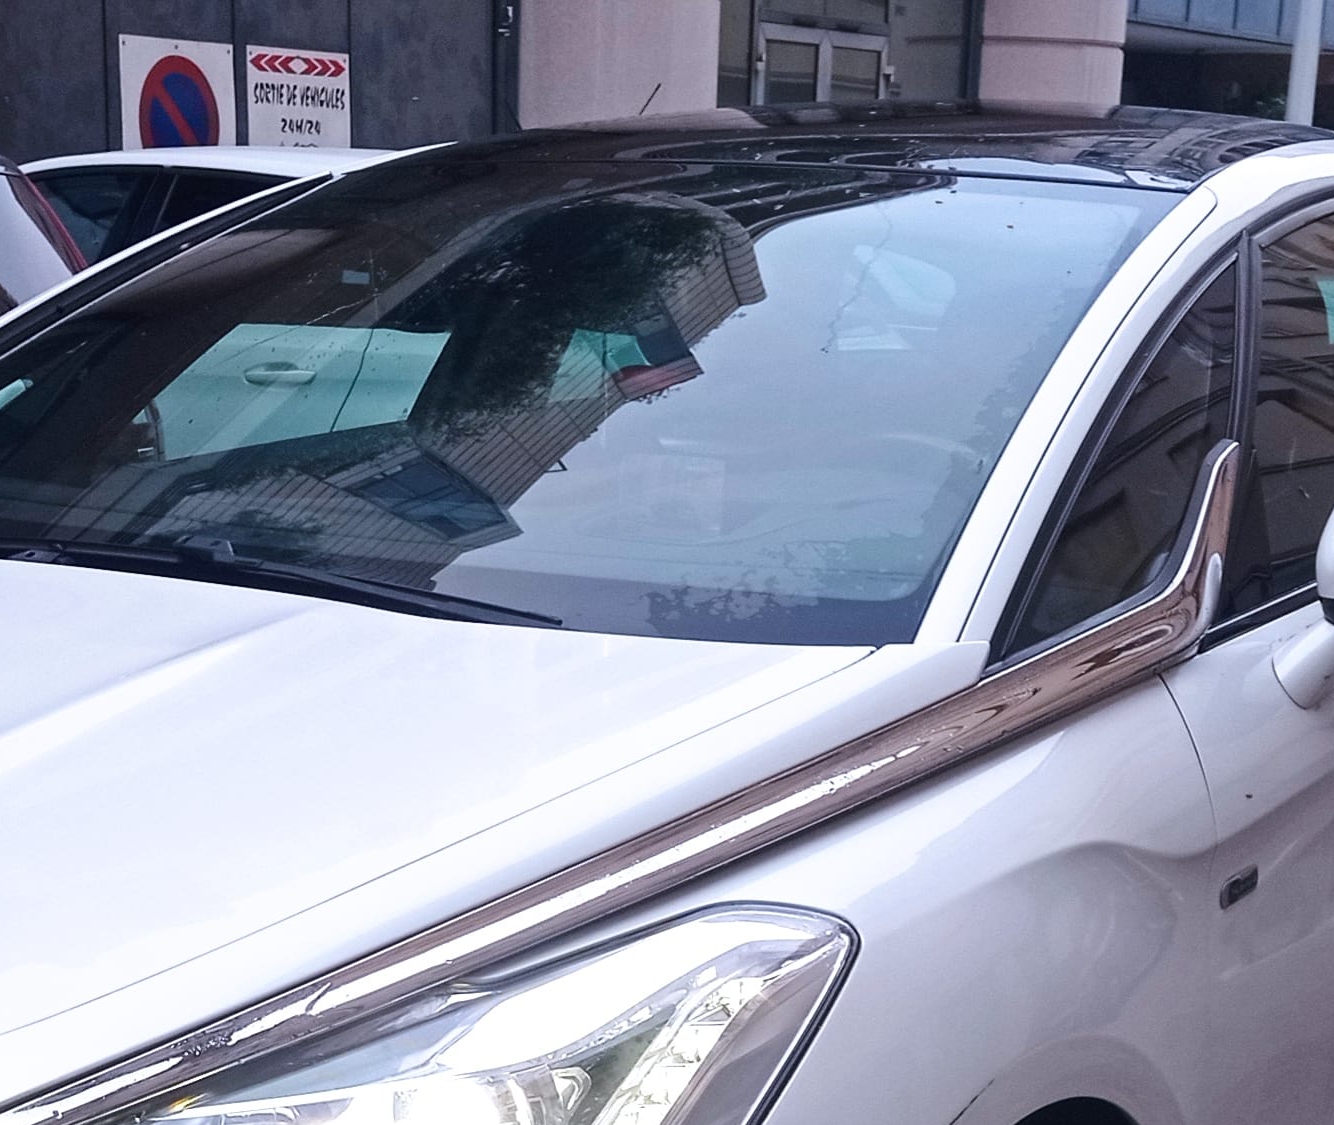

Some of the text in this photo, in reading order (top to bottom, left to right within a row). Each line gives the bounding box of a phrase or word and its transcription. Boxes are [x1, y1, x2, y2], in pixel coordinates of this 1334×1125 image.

[253, 82, 345, 110] SORTIE DE VEHICULES
[280, 117, 321, 135] 24H/24
